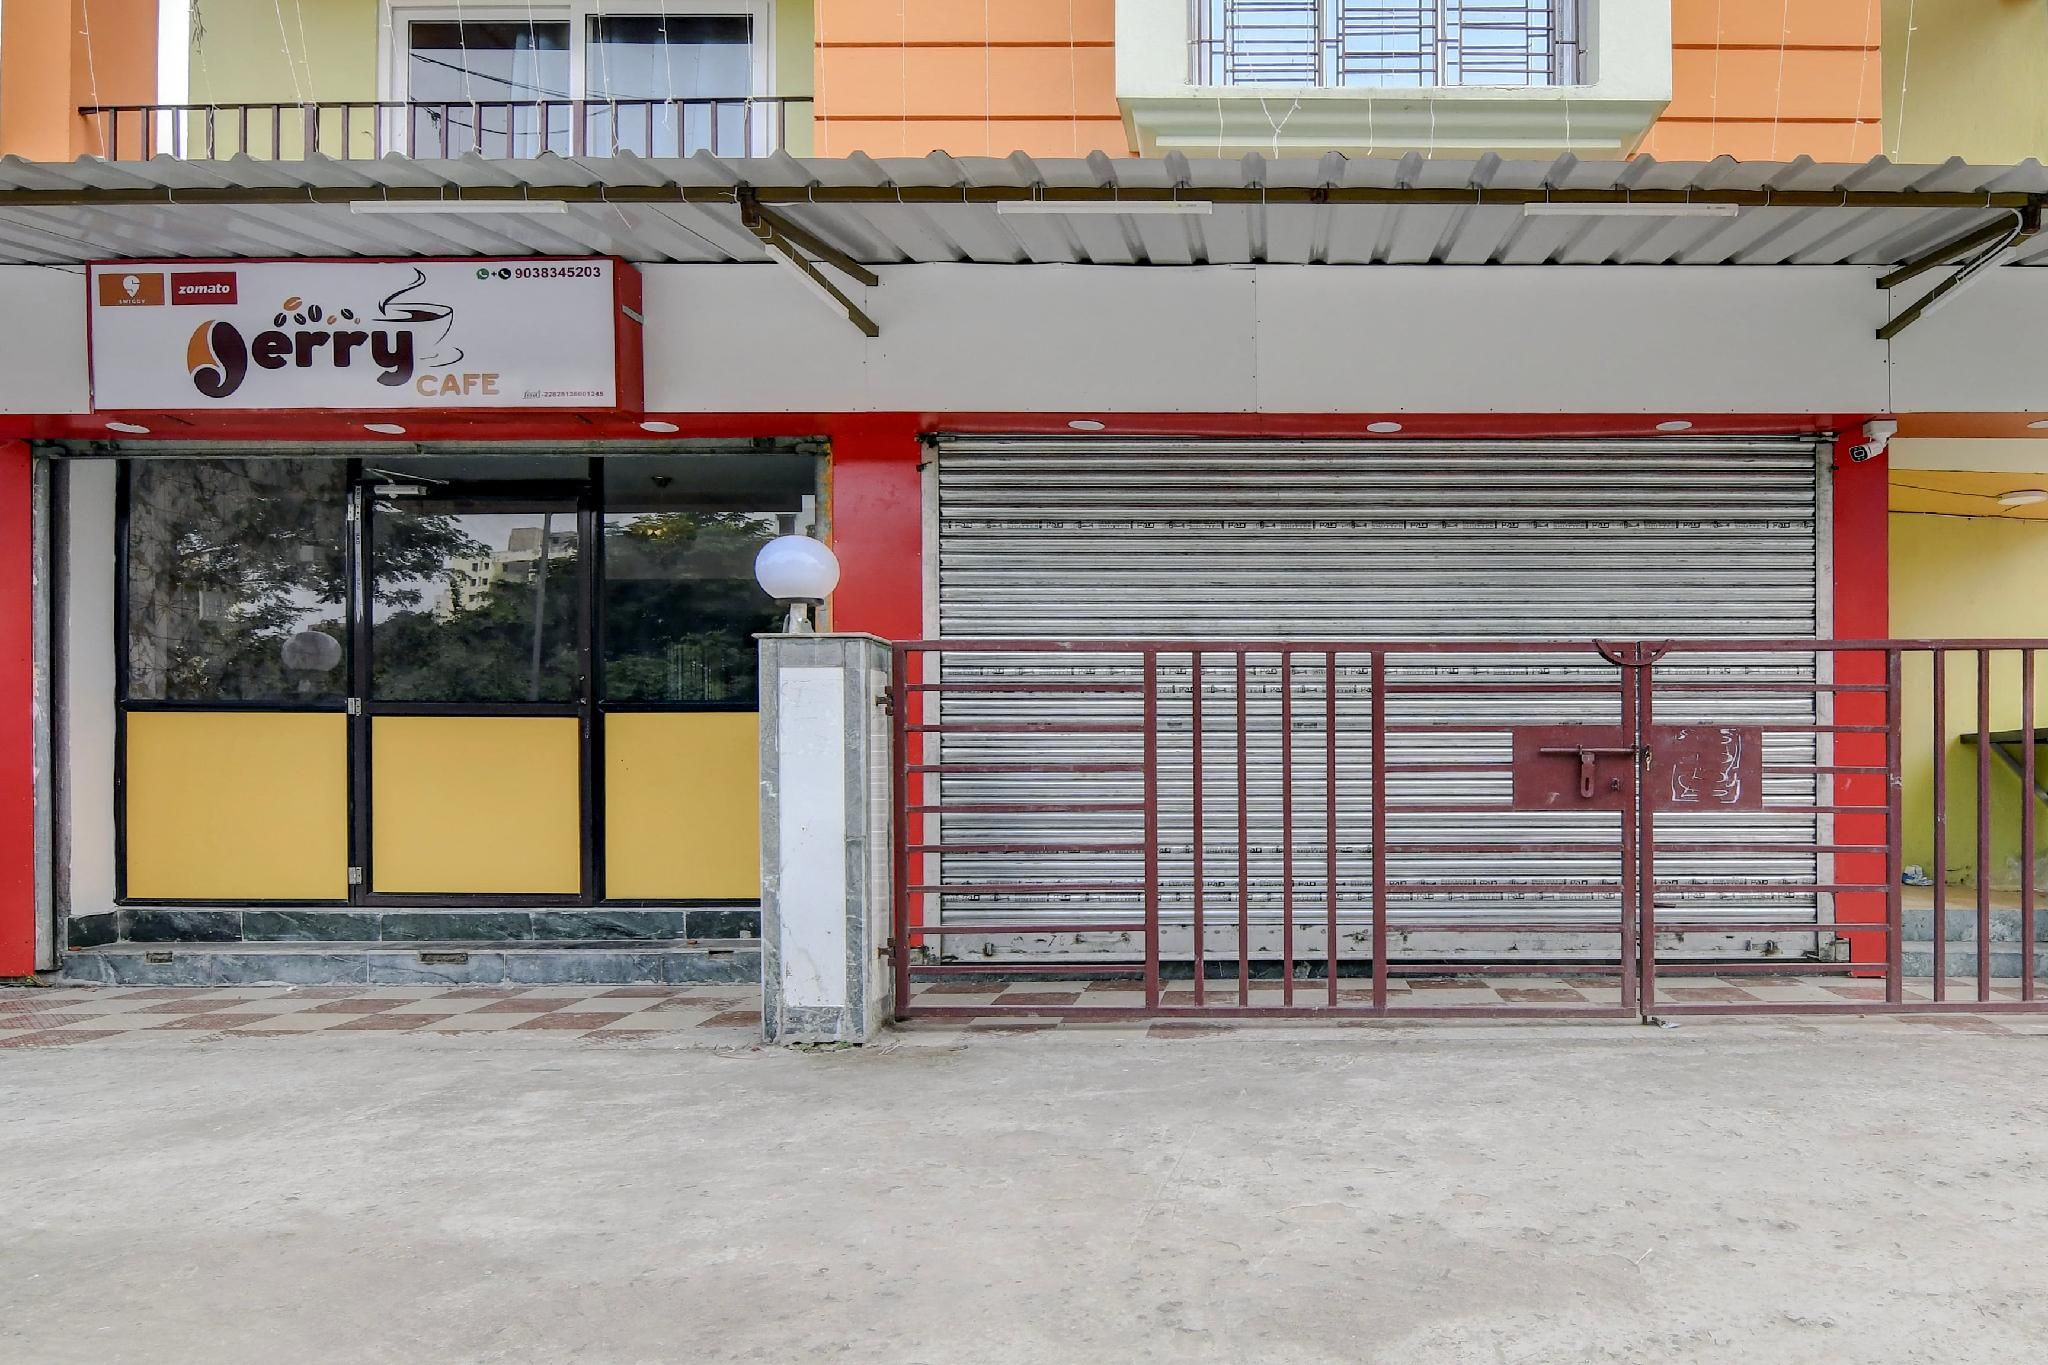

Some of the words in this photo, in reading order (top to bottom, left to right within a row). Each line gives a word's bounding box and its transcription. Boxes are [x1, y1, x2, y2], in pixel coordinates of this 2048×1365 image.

[515, 267, 601, 279] 9038345203
[178, 283, 230, 295] zomato
[186, 319, 414, 398] Jerry
[416, 373, 500, 397] CAFE
